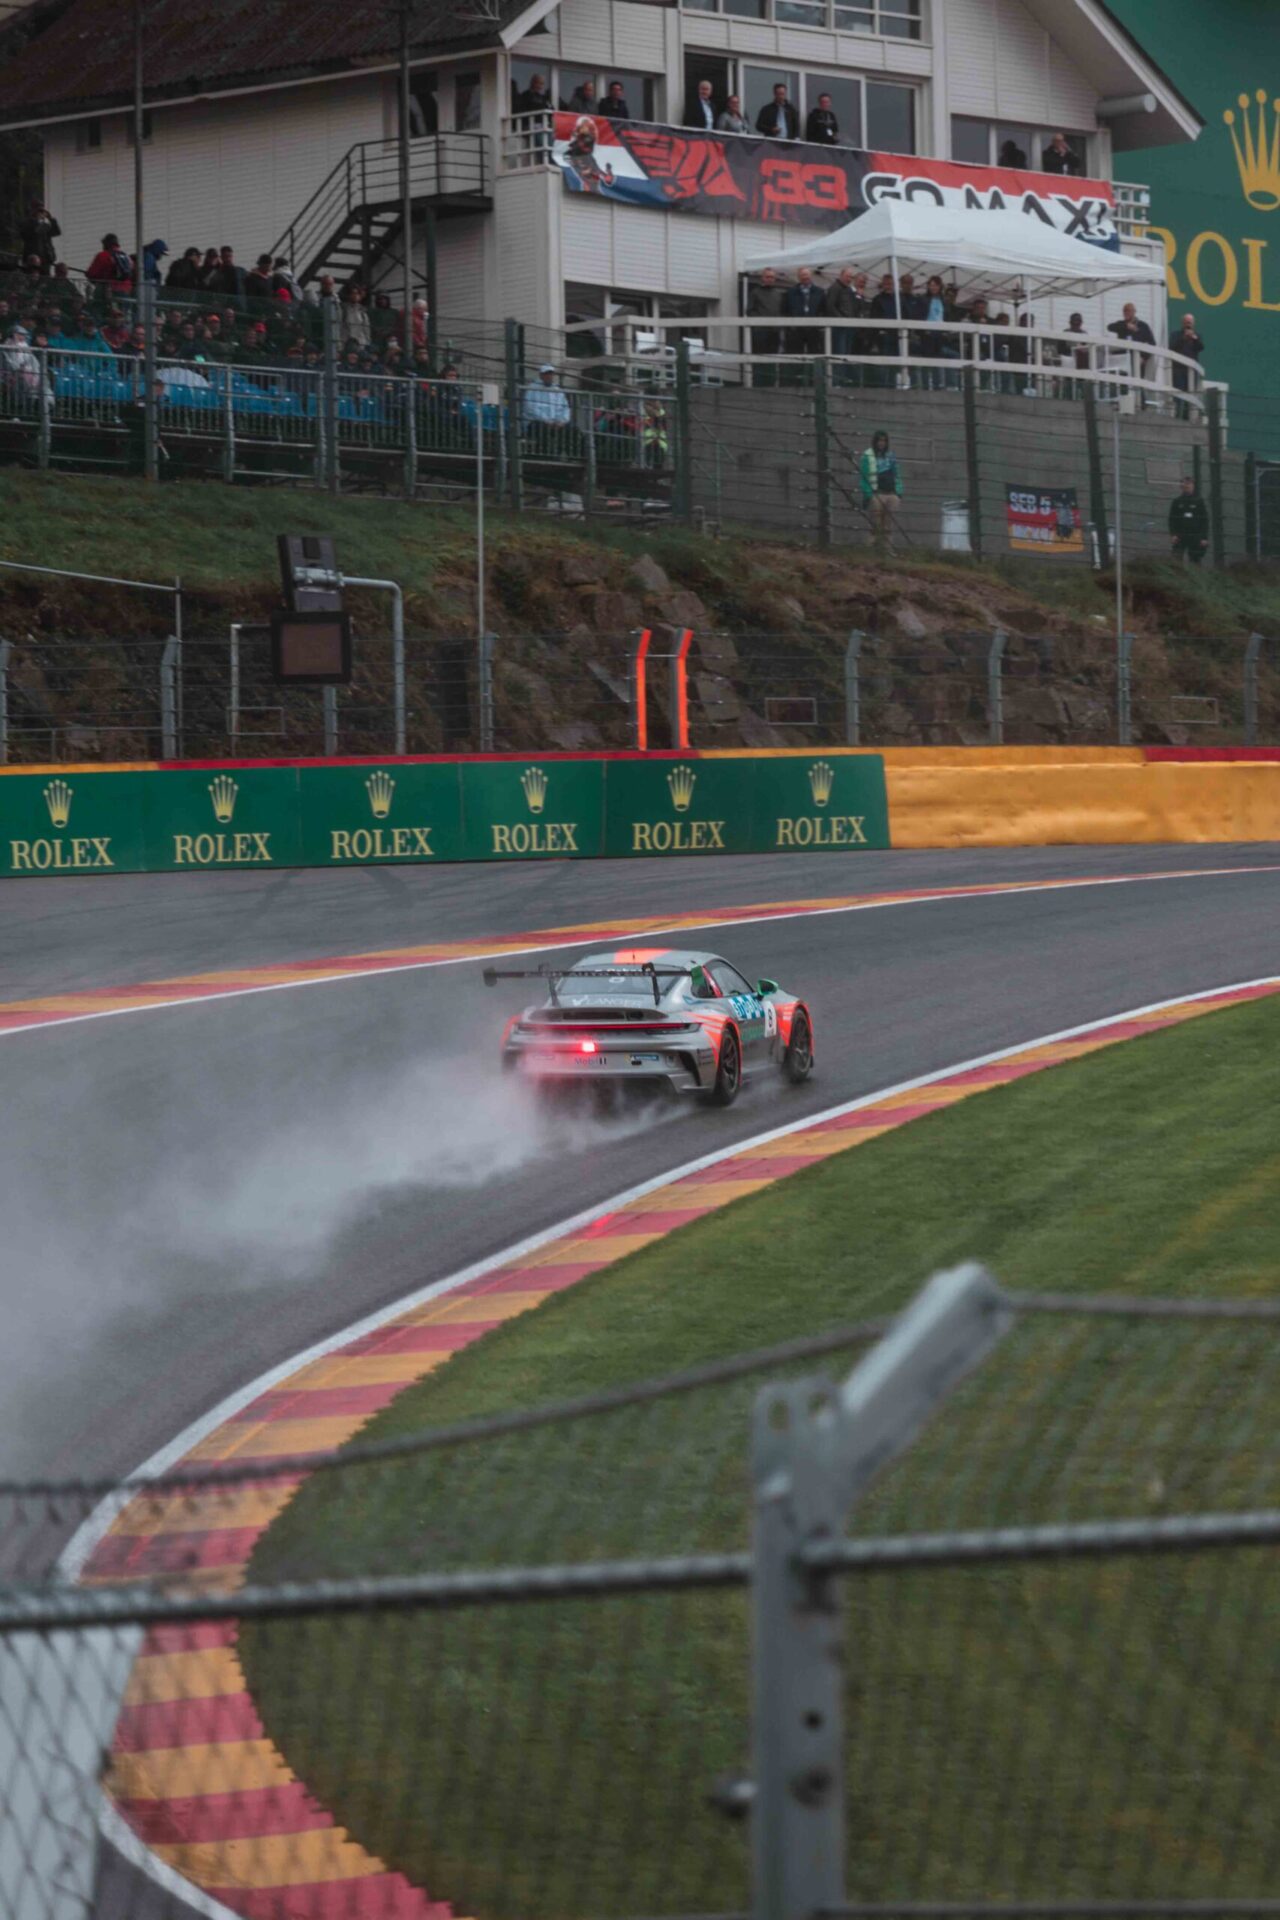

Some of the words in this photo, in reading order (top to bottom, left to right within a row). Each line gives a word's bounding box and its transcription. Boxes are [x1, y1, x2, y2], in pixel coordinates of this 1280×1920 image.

[1009, 492, 1037, 514] SEB
[330, 828, 434, 859] ROLEX
[491, 823, 579, 853] ROLEX
[632, 821, 726, 850] ROLEX
[776, 816, 868, 846] ROLEX
[10, 838, 114, 869] ROLEX
[173, 833, 272, 863] ROLEX
